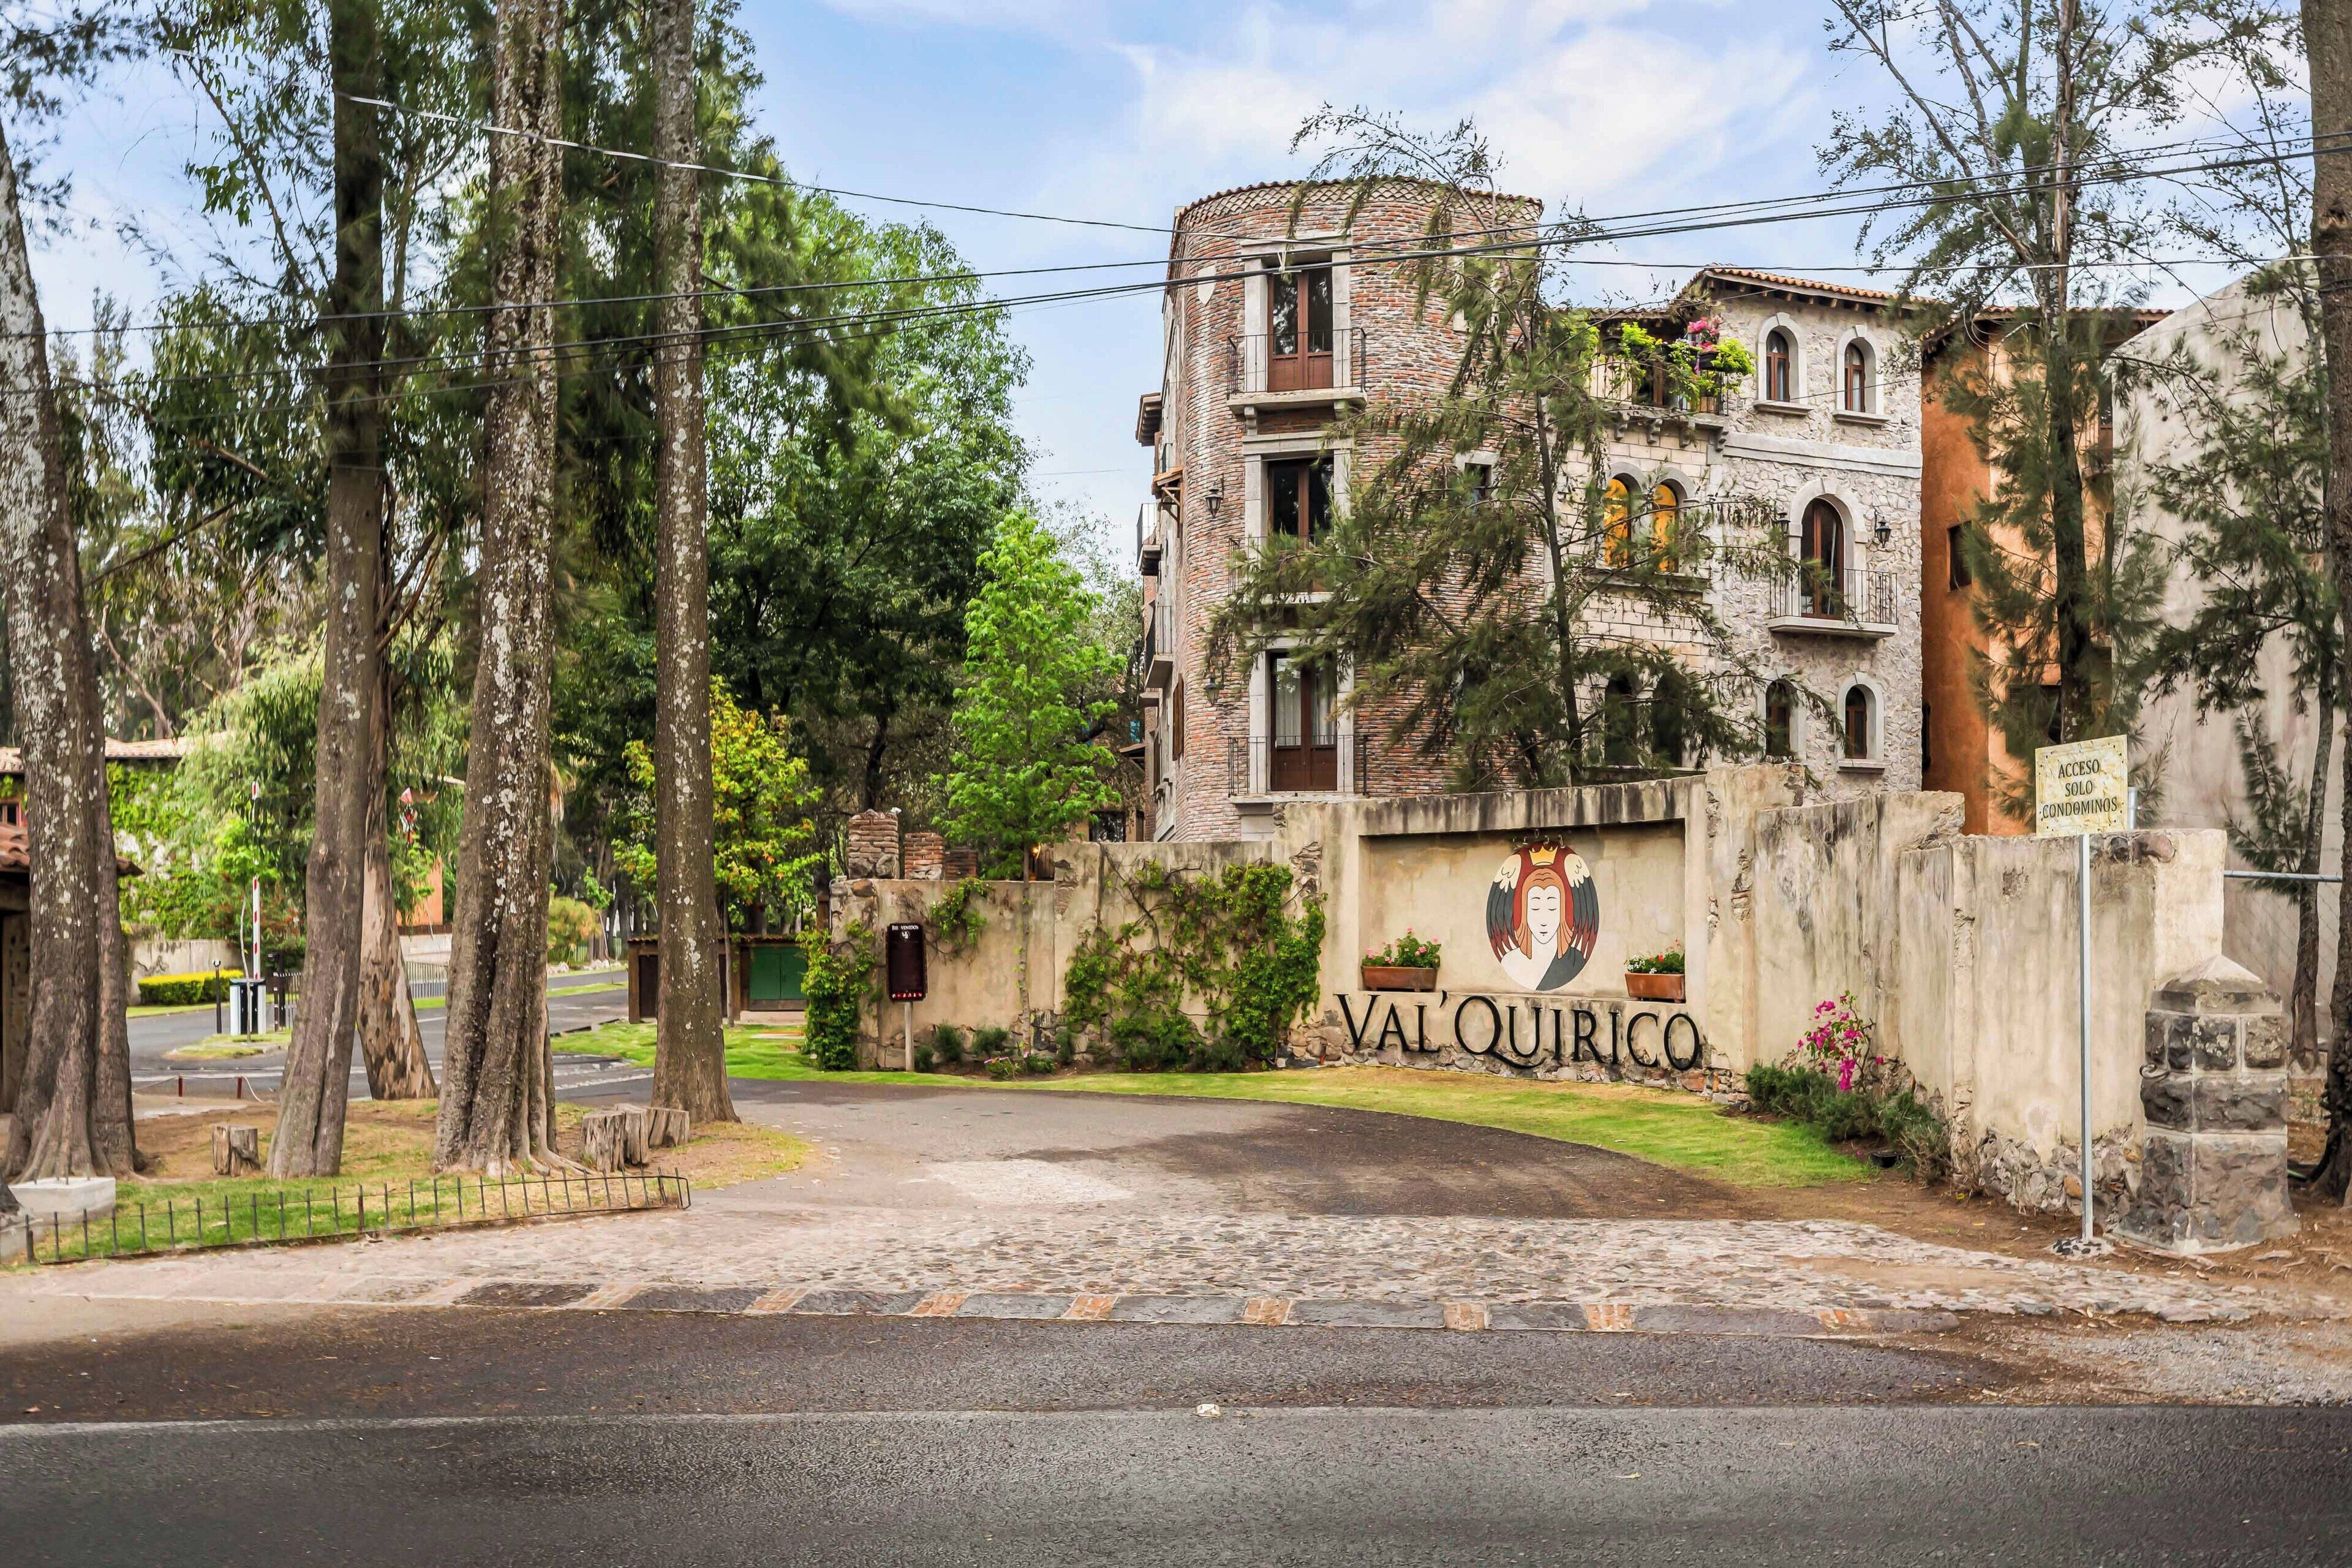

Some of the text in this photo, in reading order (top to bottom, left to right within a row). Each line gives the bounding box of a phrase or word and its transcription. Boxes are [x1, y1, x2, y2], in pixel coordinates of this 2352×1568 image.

[2058, 759, 2100, 778] ACCESO
[2065, 780, 2093, 797] SOLO
[2042, 797, 2117, 818] CONDOMINOS
